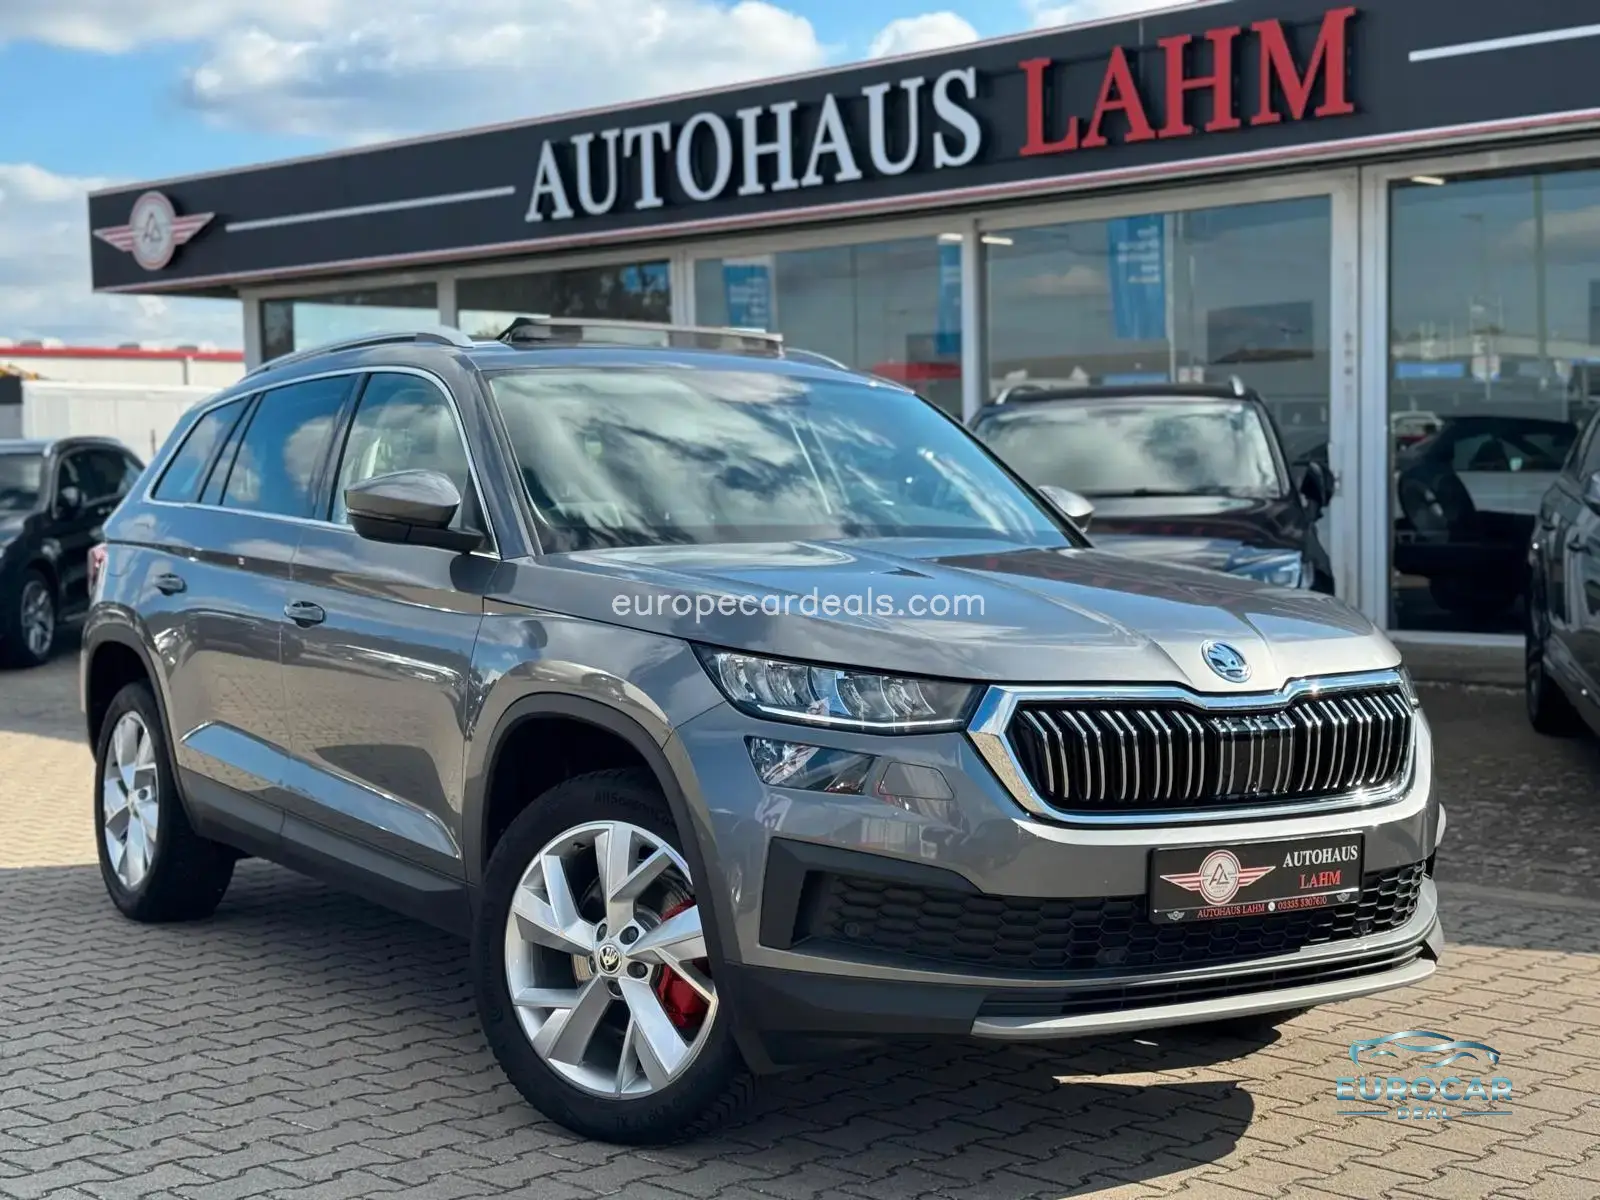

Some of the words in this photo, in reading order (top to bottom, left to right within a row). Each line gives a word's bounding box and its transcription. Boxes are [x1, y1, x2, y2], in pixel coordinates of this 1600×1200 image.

[525, 67, 982, 223] AUTOHAUS
[1019, 7, 1357, 157] LAHM
[1283, 845, 1358, 868] AUTOHAUS
[1300, 870, 1342, 889] LAHM
[1197, 906, 1241, 919] AUTOHAUS
[1243, 903, 1265, 914] LAHM
